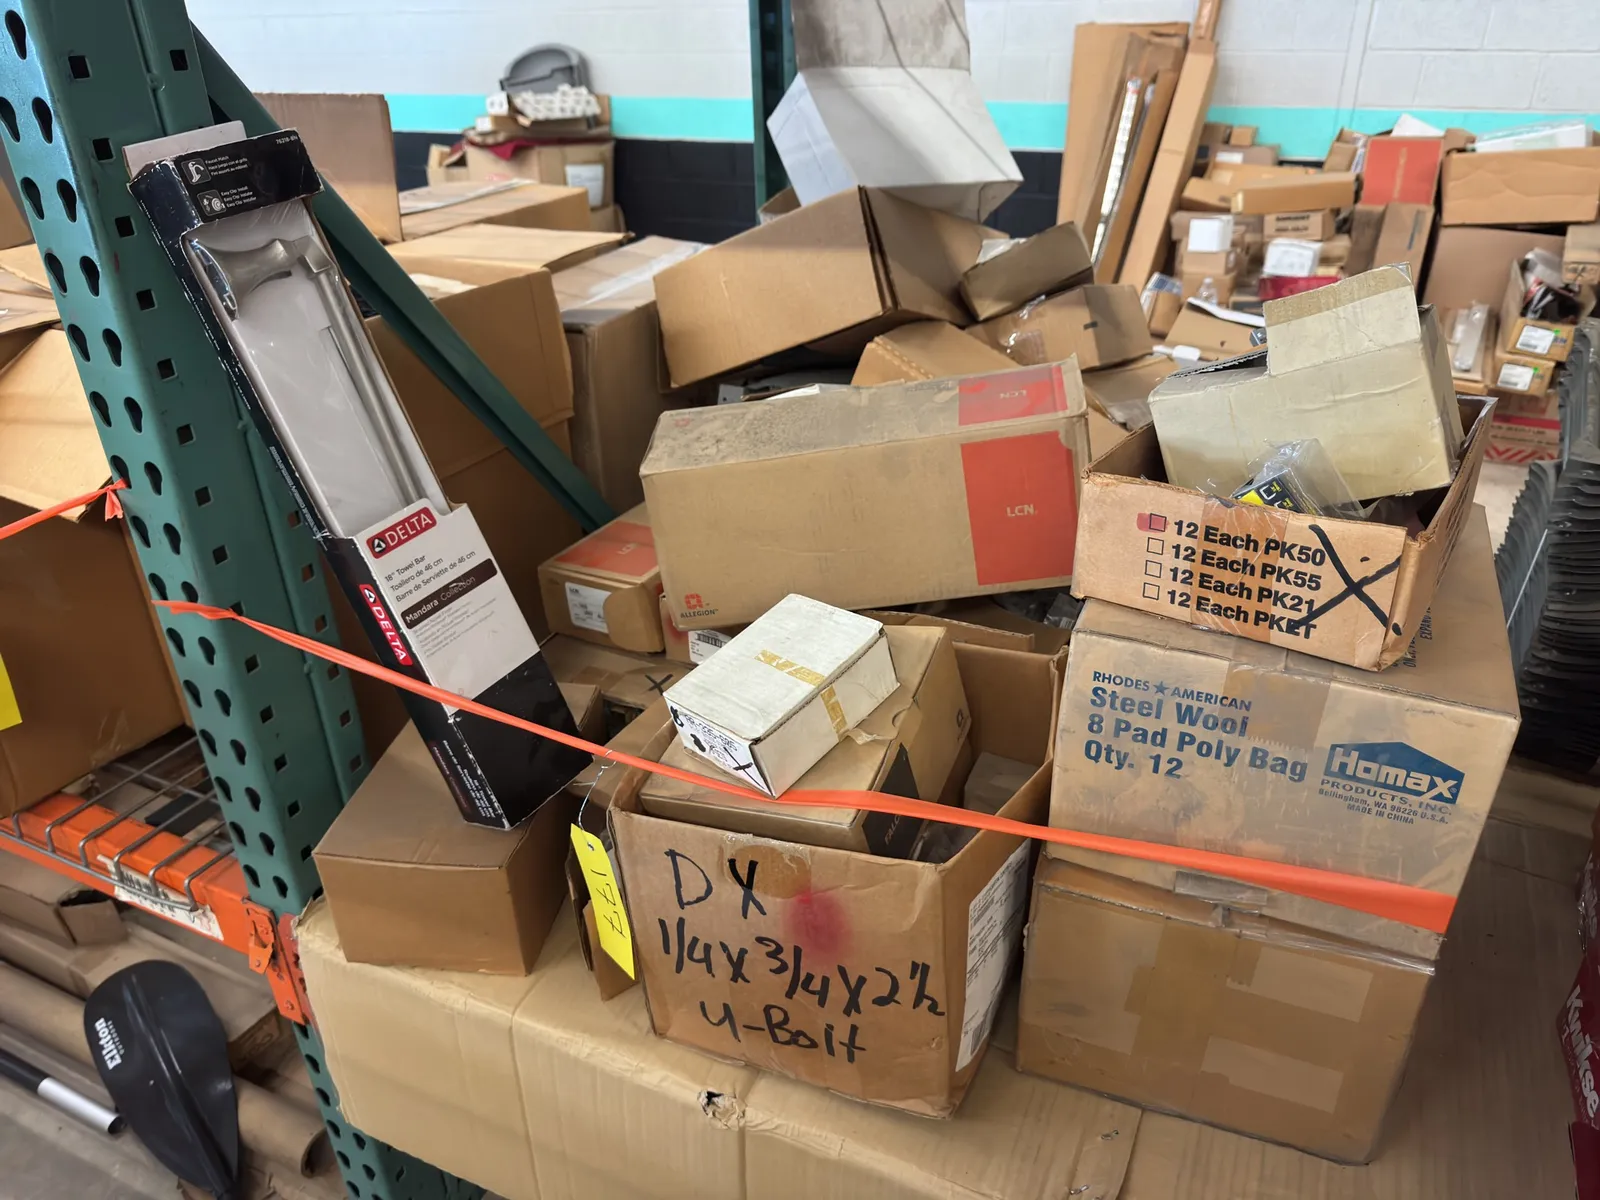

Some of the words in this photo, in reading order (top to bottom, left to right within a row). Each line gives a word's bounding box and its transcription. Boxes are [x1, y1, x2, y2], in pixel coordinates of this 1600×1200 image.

[385, 513, 432, 546] DELTA
[1006, 504, 1034, 517] LCN
[396, 561, 415, 576] Towel
[414, 555, 426, 566] Bar
[1174, 520, 1199, 539] 12
[1203, 525, 1259, 552] Each
[1264, 538, 1326, 566] PK50
[390, 575, 415, 592] Toallero
[415, 569, 424, 578] de
[424, 563, 433, 572] 46
[433, 558, 444, 567] cm
[395, 588, 414, 602] Barre
[413, 582, 422, 592] de
[421, 567, 449, 586] Serviette
[449, 562, 458, 570] de
[466, 550, 476, 560] cm
[1169, 566, 1194, 585] 12
[1198, 572, 1252, 601] Each
[1257, 586, 1315, 614] PK21
[1172, 544, 1196, 562] 12
[1201, 549, 1256, 576] Each
[1260, 562, 1322, 591] PK55
[405, 599, 439, 623] Mandara
[440, 576, 476, 601] Collection
[1167, 590, 1191, 608] 12
[1196, 595, 1249, 623] Each
[372, 606, 407, 660] DELTA
[1090, 686, 1164, 719] Steel
[1175, 702, 1250, 737] Wool
[1093, 671, 1150, 691] RHODES
[1170, 687, 1252, 711] AMERICAN
[1084, 739, 1135, 770] Qty.
[1149, 753, 1184, 779] 12
[1087, 713, 1104, 734] 8
[1113, 717, 1168, 748] Pad
[1176, 730, 1241, 767] Poly
[1248, 746, 1309, 783] Bag
[1330, 747, 1458, 800] Homax
[1347, 803, 1373, 815] MADE
[1375, 809, 1385, 818] IN
[1387, 812, 1414, 825] CHINA
[1374, 800, 1388, 810] WA
[1418, 801, 1452, 815] INC.
[664, 848, 713, 910] D
[94, 1017, 122, 1070] Elkton
